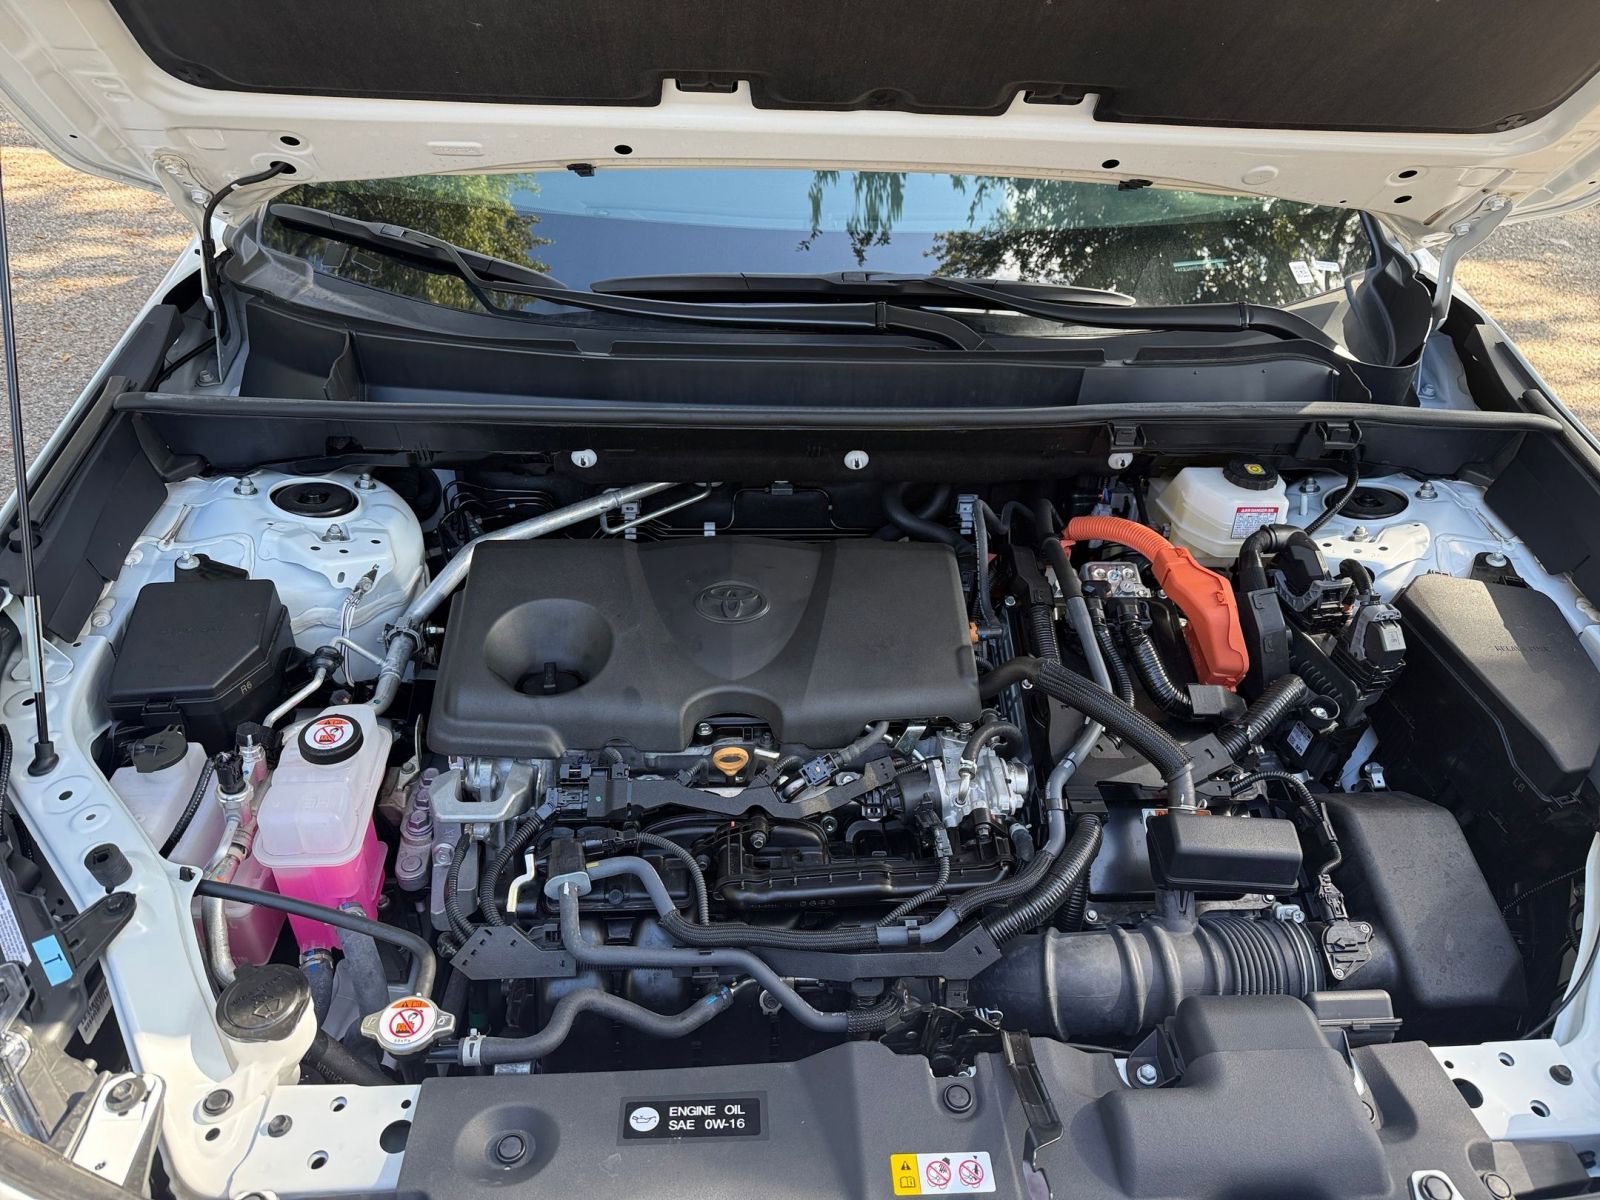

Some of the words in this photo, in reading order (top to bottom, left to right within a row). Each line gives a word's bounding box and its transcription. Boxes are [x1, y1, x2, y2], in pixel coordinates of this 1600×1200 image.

[240, 680, 253, 695] R6
[44, 953, 63, 965] T
[668, 1105, 716, 1117] ENGINE
[724, 1104, 746, 1115] OIL
[668, 1119, 695, 1131] SAE
[704, 1118, 746, 1130] 0W-16
